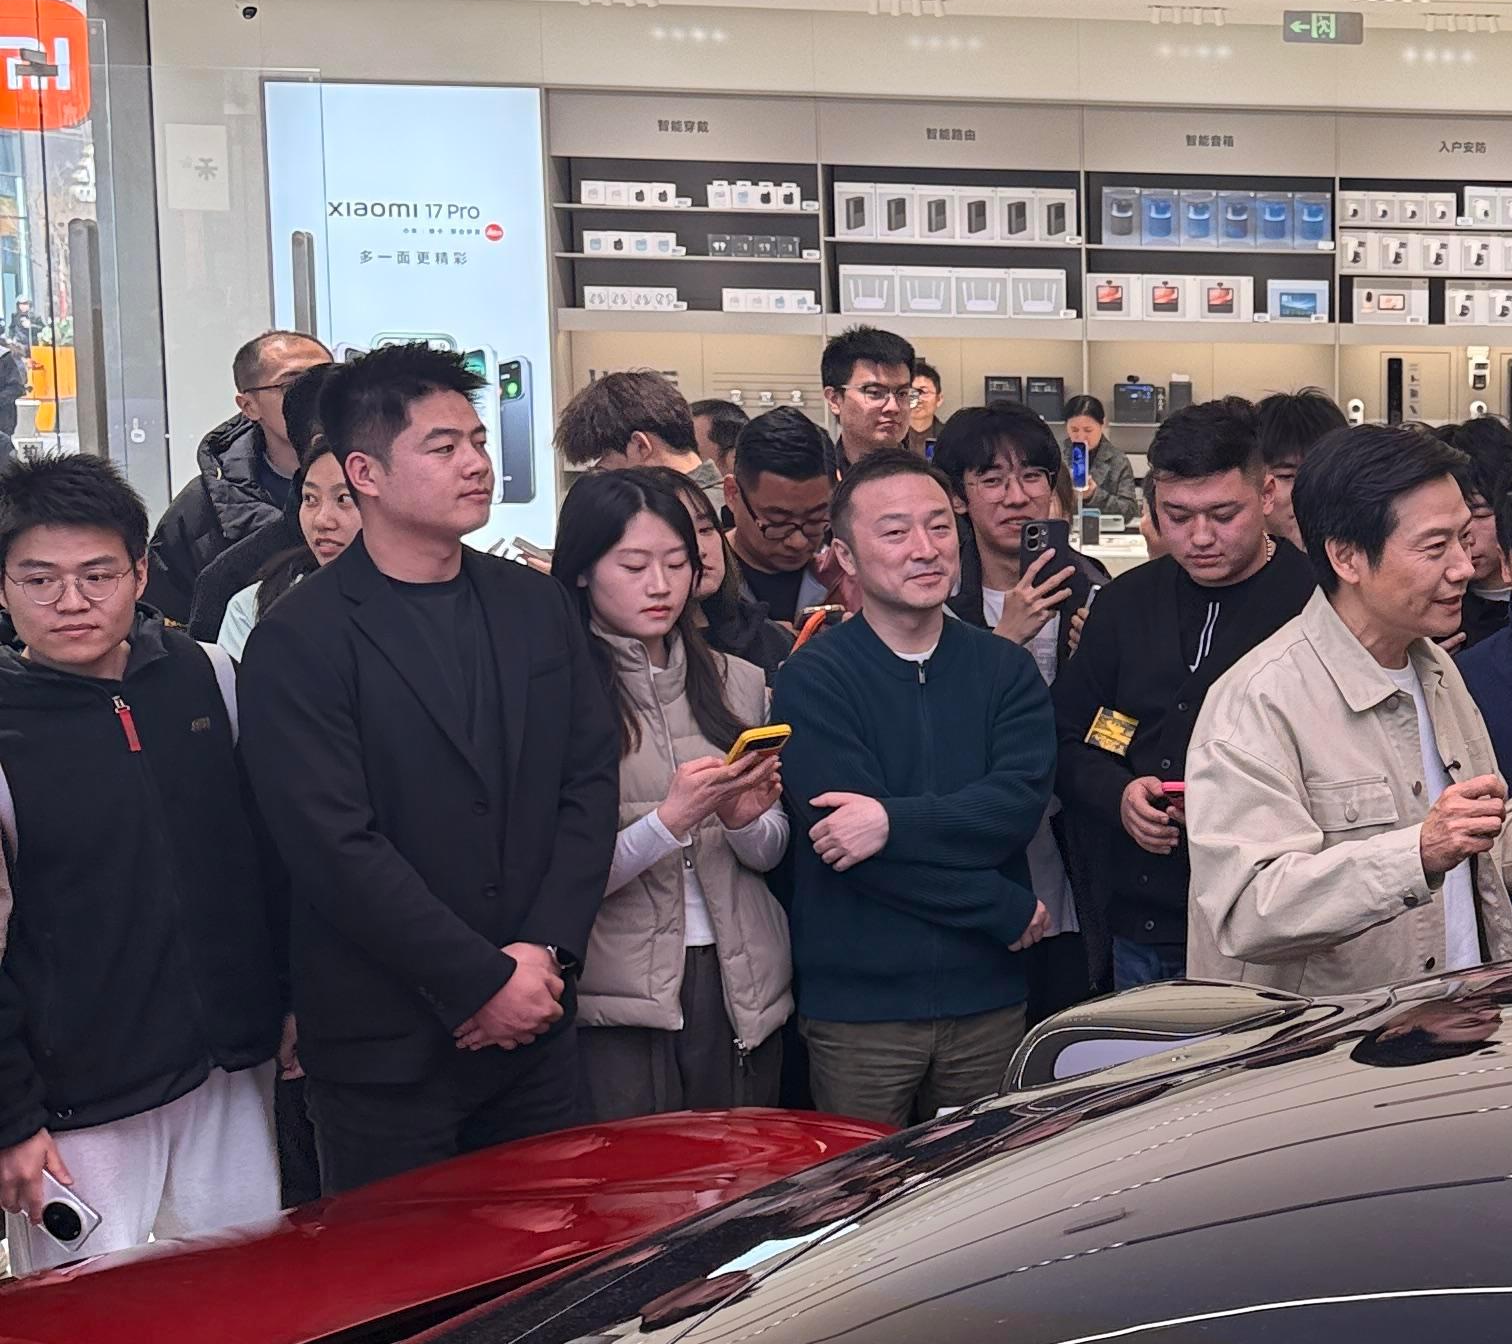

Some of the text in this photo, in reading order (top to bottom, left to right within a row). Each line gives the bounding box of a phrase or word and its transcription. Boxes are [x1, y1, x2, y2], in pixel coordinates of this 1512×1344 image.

[925, 127, 977, 142] 智能路由
[1438, 140, 1487, 154] 入户安防
[327, 201, 480, 220] xiaomi 17 Pro
[359, 249, 468, 265] 多一面更精彩
